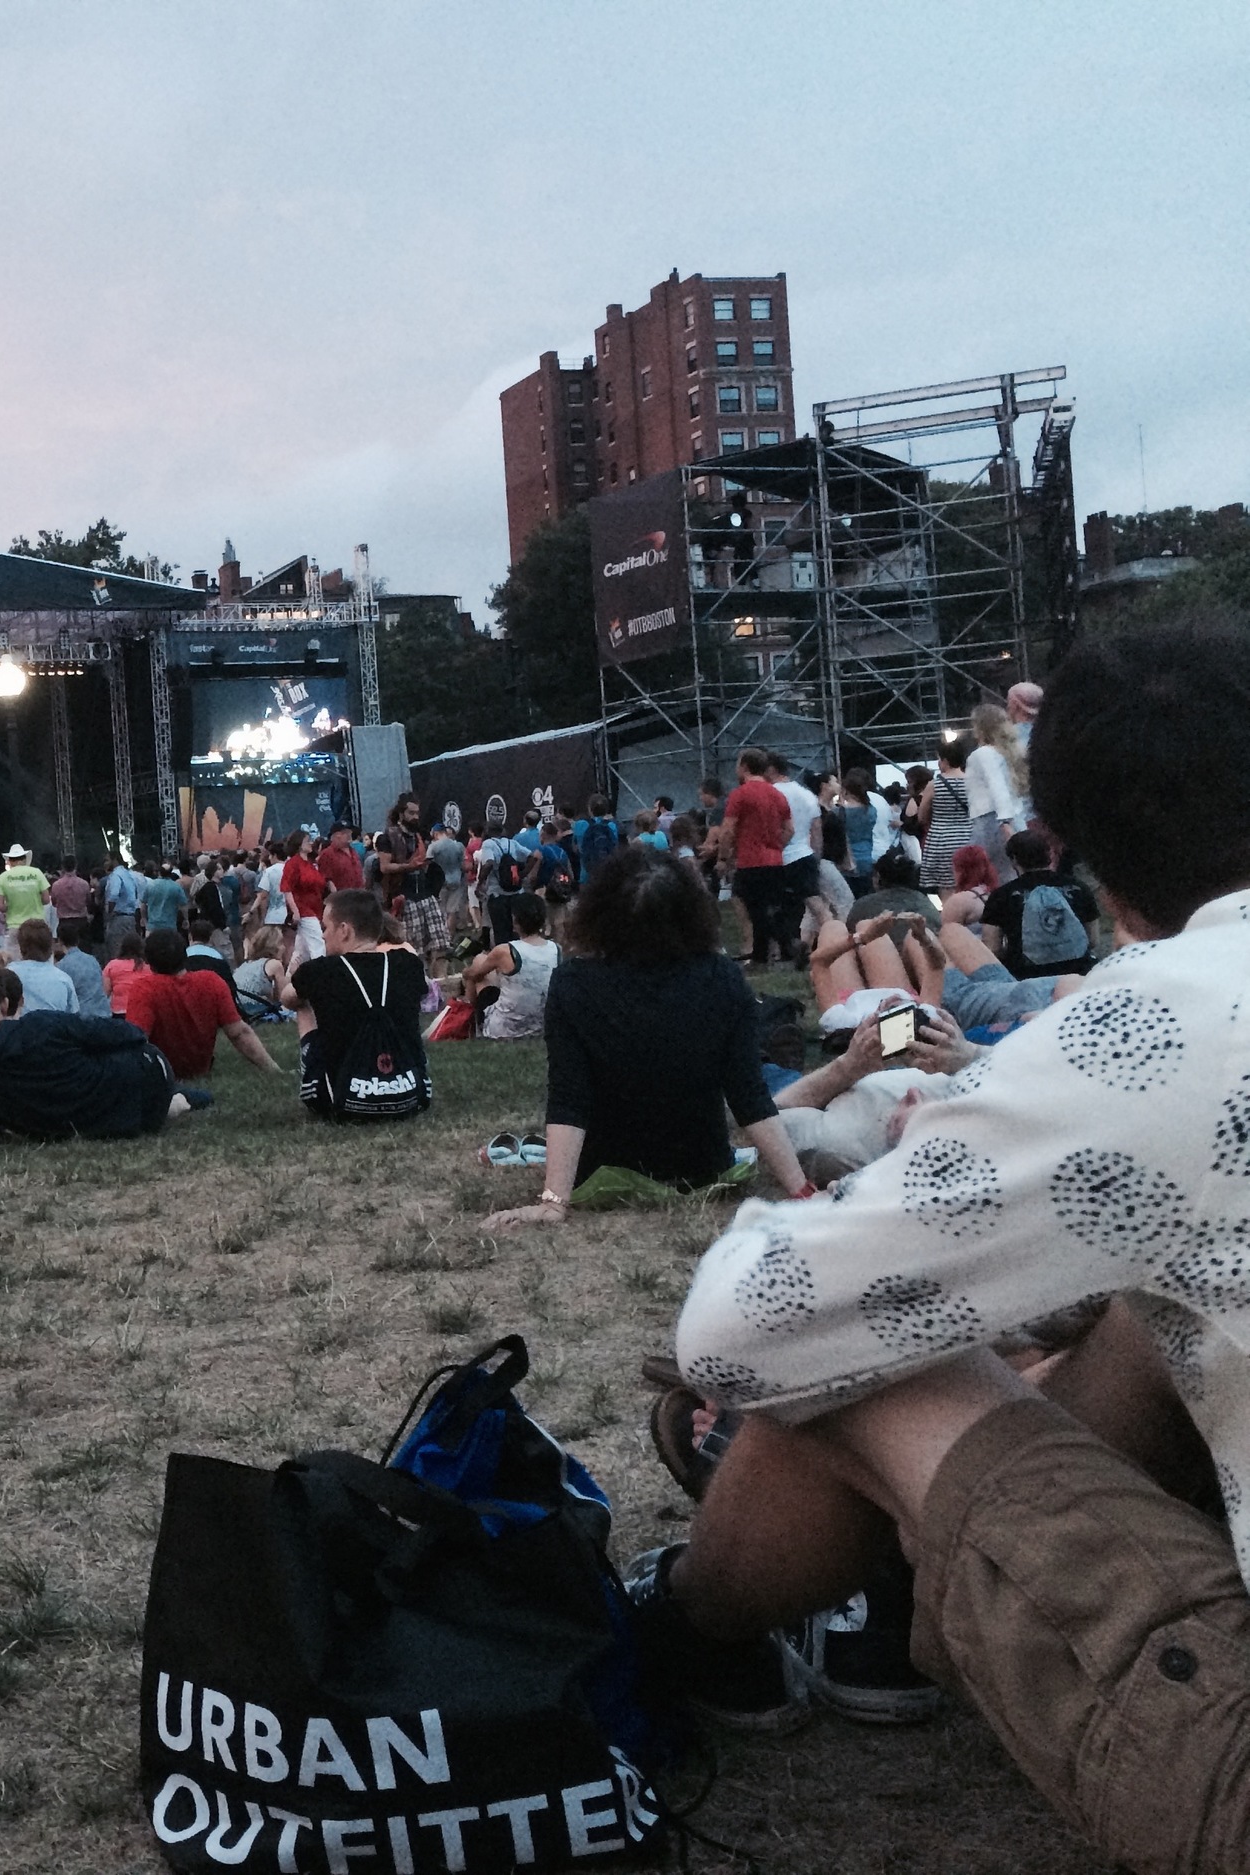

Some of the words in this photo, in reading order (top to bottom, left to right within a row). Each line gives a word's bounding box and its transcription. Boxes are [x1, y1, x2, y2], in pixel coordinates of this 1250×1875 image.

[350, 1070, 417, 1099] splash!
[156, 1671, 451, 1791] URBAN
[153, 1747, 659, 1875] OUTFITTER
